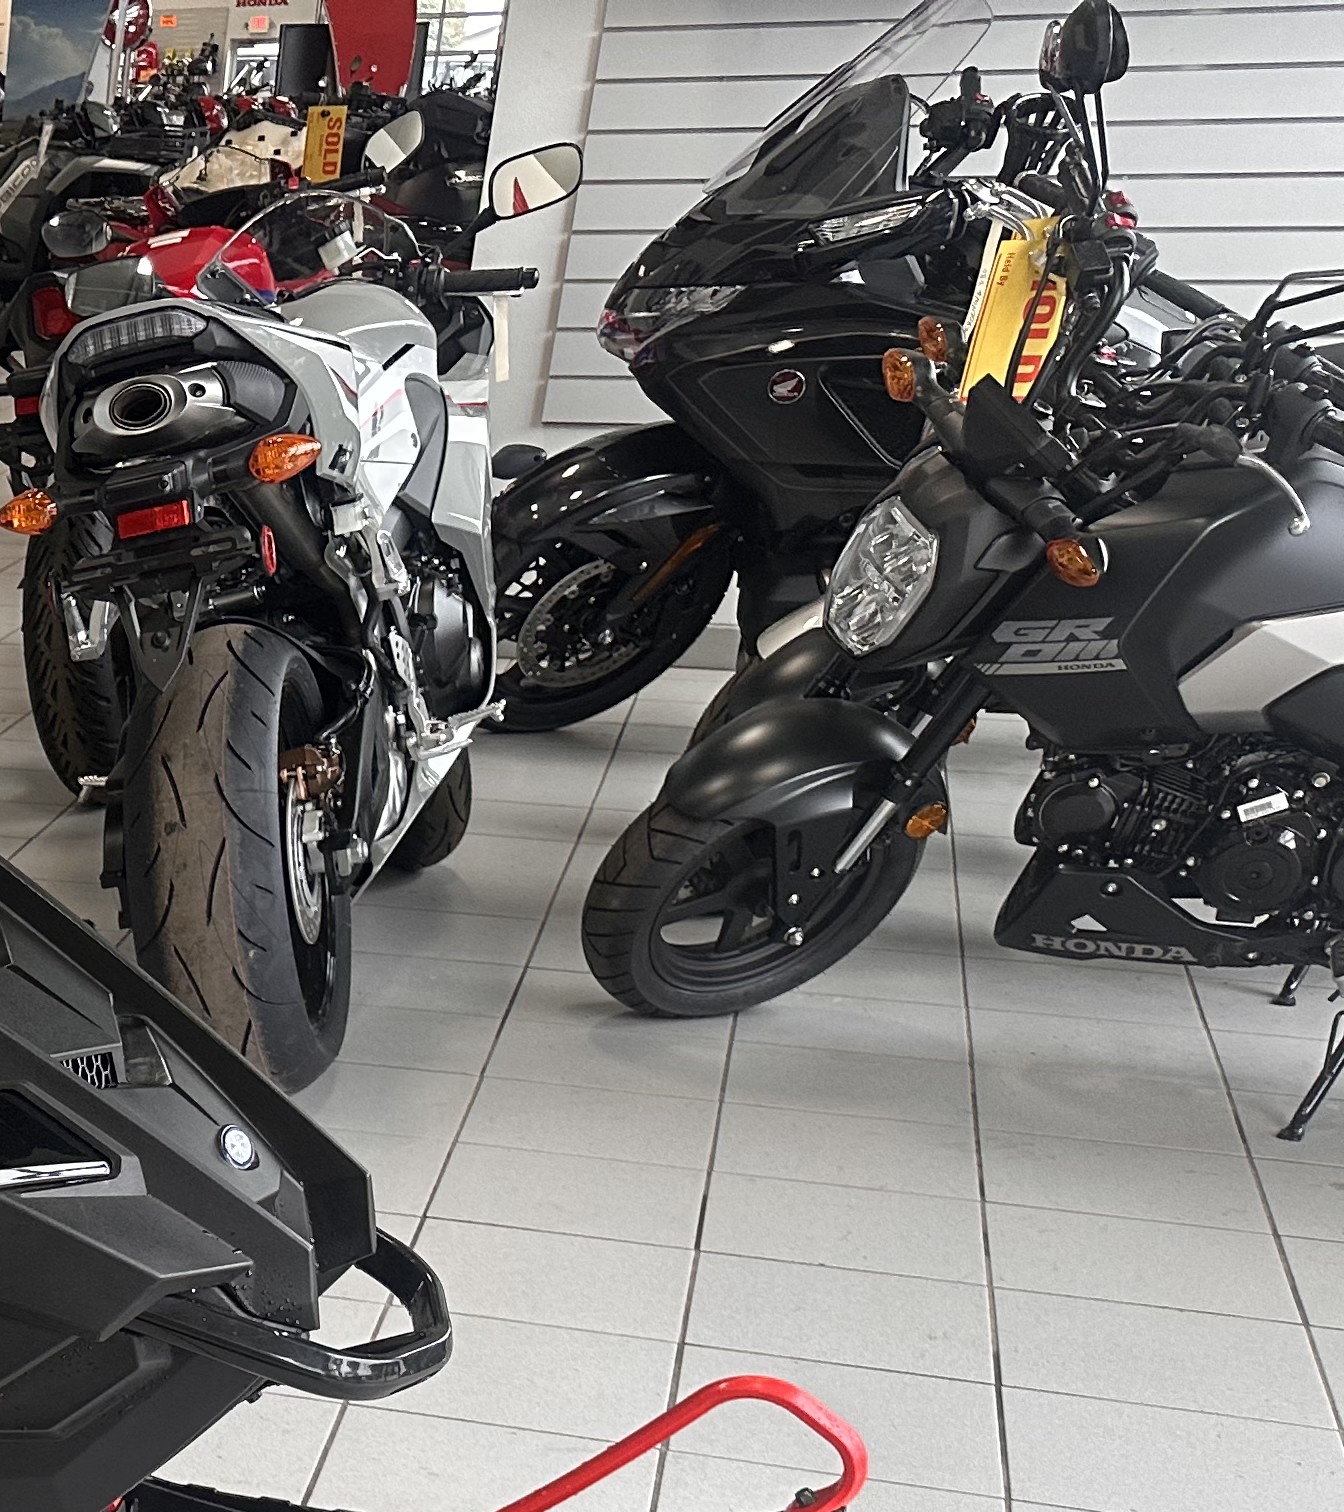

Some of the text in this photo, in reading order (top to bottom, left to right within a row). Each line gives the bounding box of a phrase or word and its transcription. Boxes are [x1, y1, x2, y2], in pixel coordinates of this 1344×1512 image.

[321, 117, 343, 176] SOLD
[1057, 663, 1116, 672] HONDA
[1031, 934, 1197, 963] HONDA
